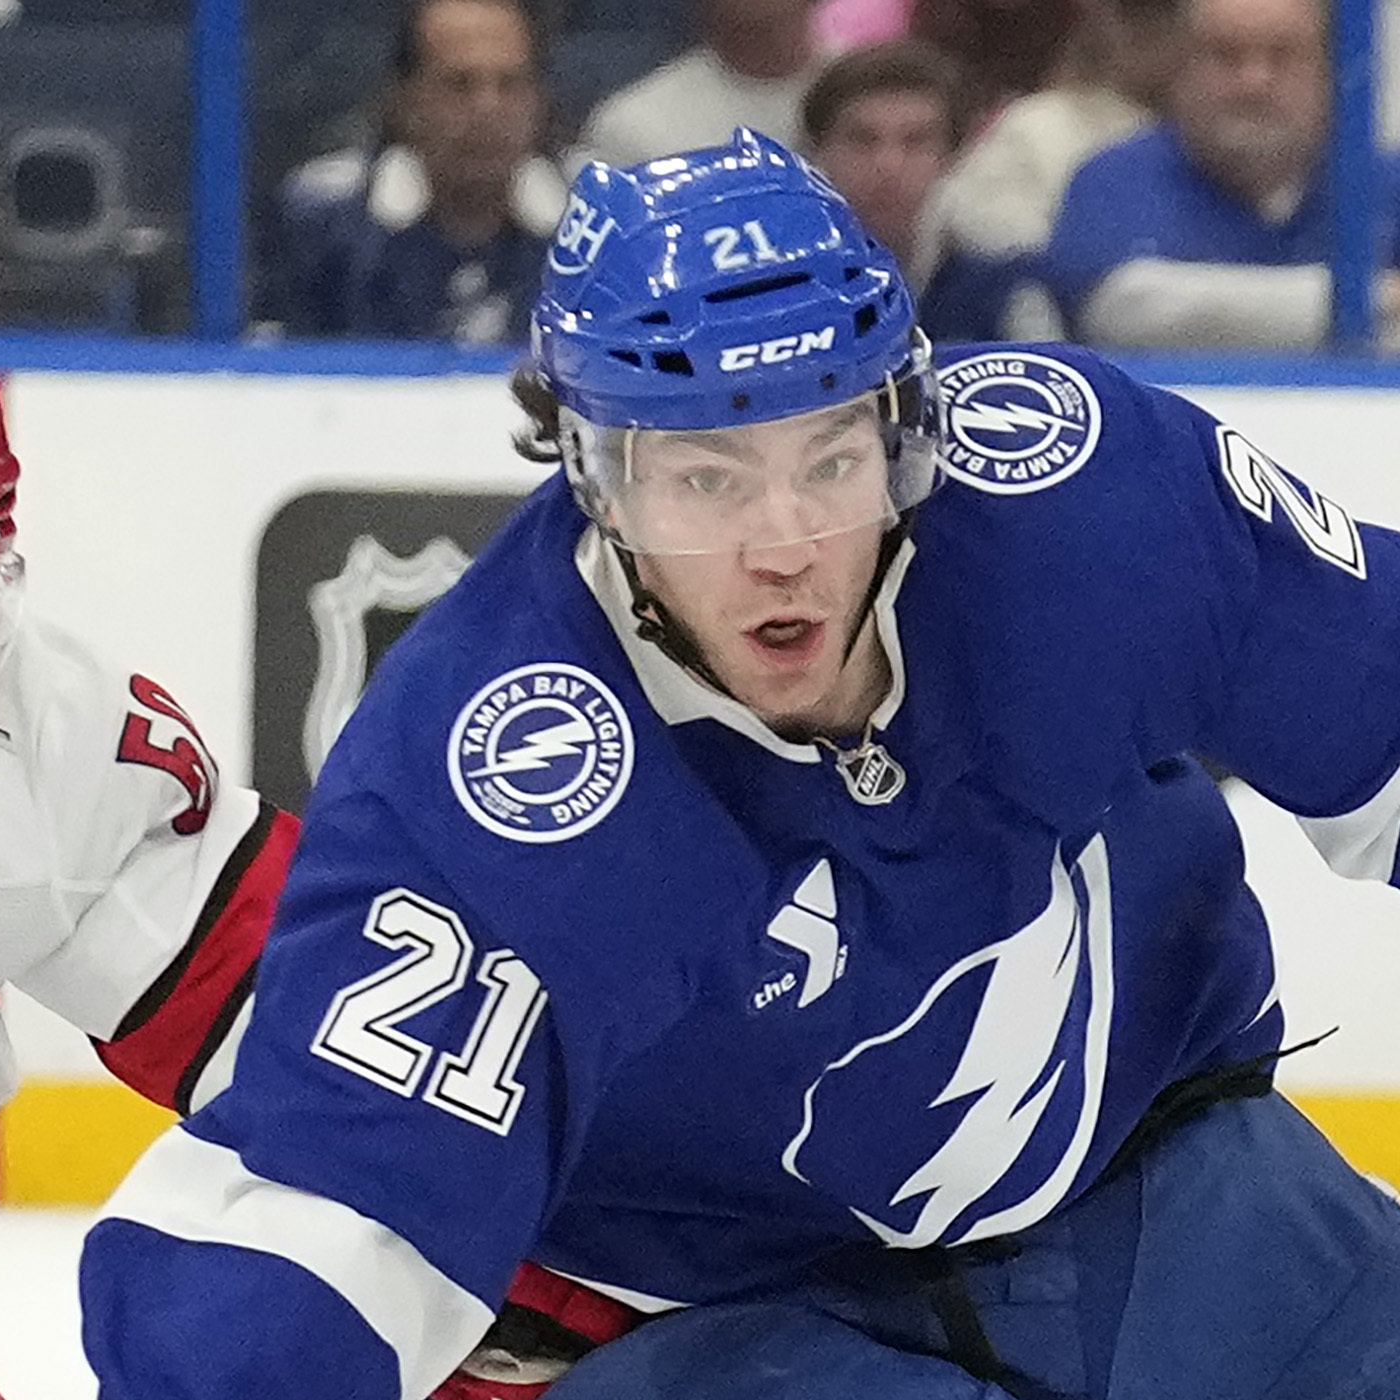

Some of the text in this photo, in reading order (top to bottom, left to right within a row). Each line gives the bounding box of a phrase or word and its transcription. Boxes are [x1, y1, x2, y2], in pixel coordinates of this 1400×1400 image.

[557, 193, 616, 264] GH
[703, 220, 778, 271] 21
[719, 326, 836, 372] CCM
[994, 440, 1078, 480] TAMPA
[534, 675, 587, 700] BAY
[462, 682, 528, 756] TAMPA
[550, 697, 623, 825] LIGHTNING
[308, 886, 549, 1137] 21
[754, 971, 798, 1010] the
